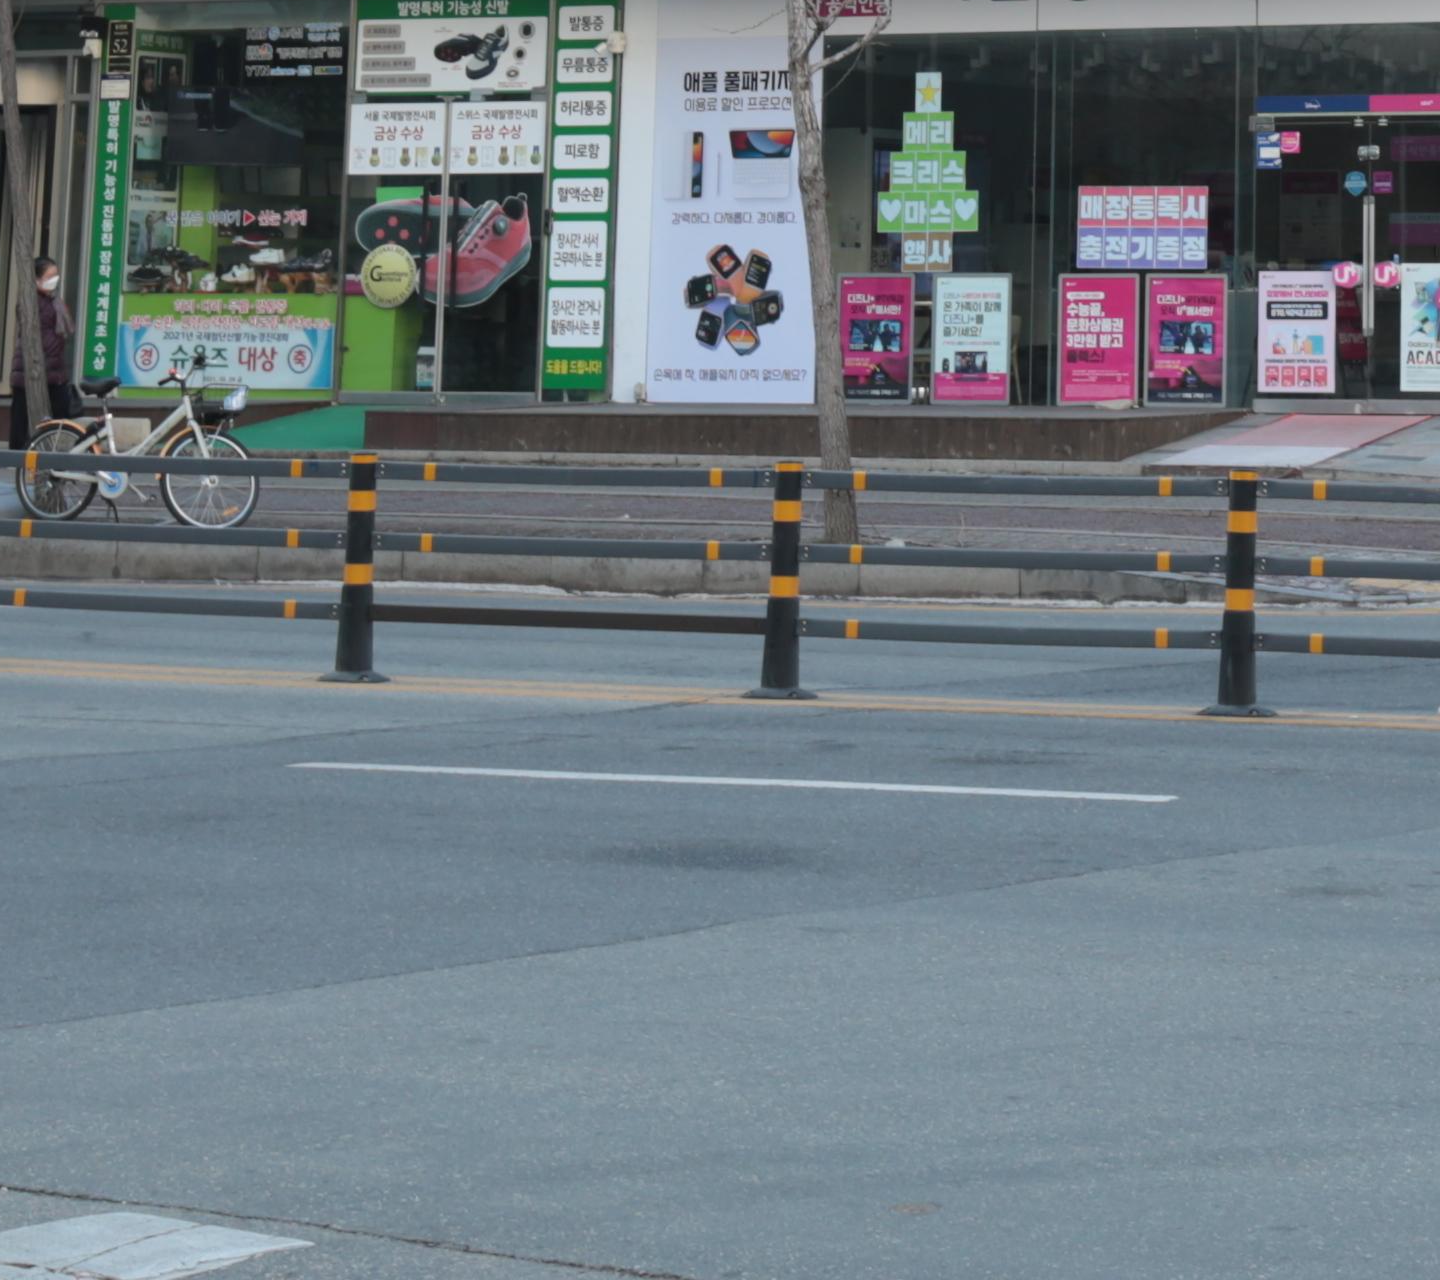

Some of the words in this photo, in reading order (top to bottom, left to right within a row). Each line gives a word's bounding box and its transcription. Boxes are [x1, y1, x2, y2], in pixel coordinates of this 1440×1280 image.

[397, 1, 444, 17] 발명특허
[447, 0, 483, 16] 기능성
[486, 0, 509, 15] 신발
[569, 16, 604, 32] 발통증
[684, 72, 718, 93] 애플
[560, 100, 607, 116] 허리통증
[684, 97, 718, 112] 이용료
[722, 97, 744, 112] 할인
[374, 127, 398, 140] 금상
[400, 126, 424, 140] 수상
[472, 126, 495, 140] 금상
[498, 125, 522, 139] 수상
[906, 120, 951, 144] 메리
[565, 143, 600, 159] 피로함
[102, 159, 116, 202] 기능성
[893, 158, 963, 184] 크리스
[557, 185, 604, 204] 혈액순환
[905, 201, 951, 225] 마스
[904, 241, 951, 264] 행사
[1079, 235, 1206, 261] 충전기증정
[140, 348, 153, 365] 경
[238, 346, 277, 372] 대상
